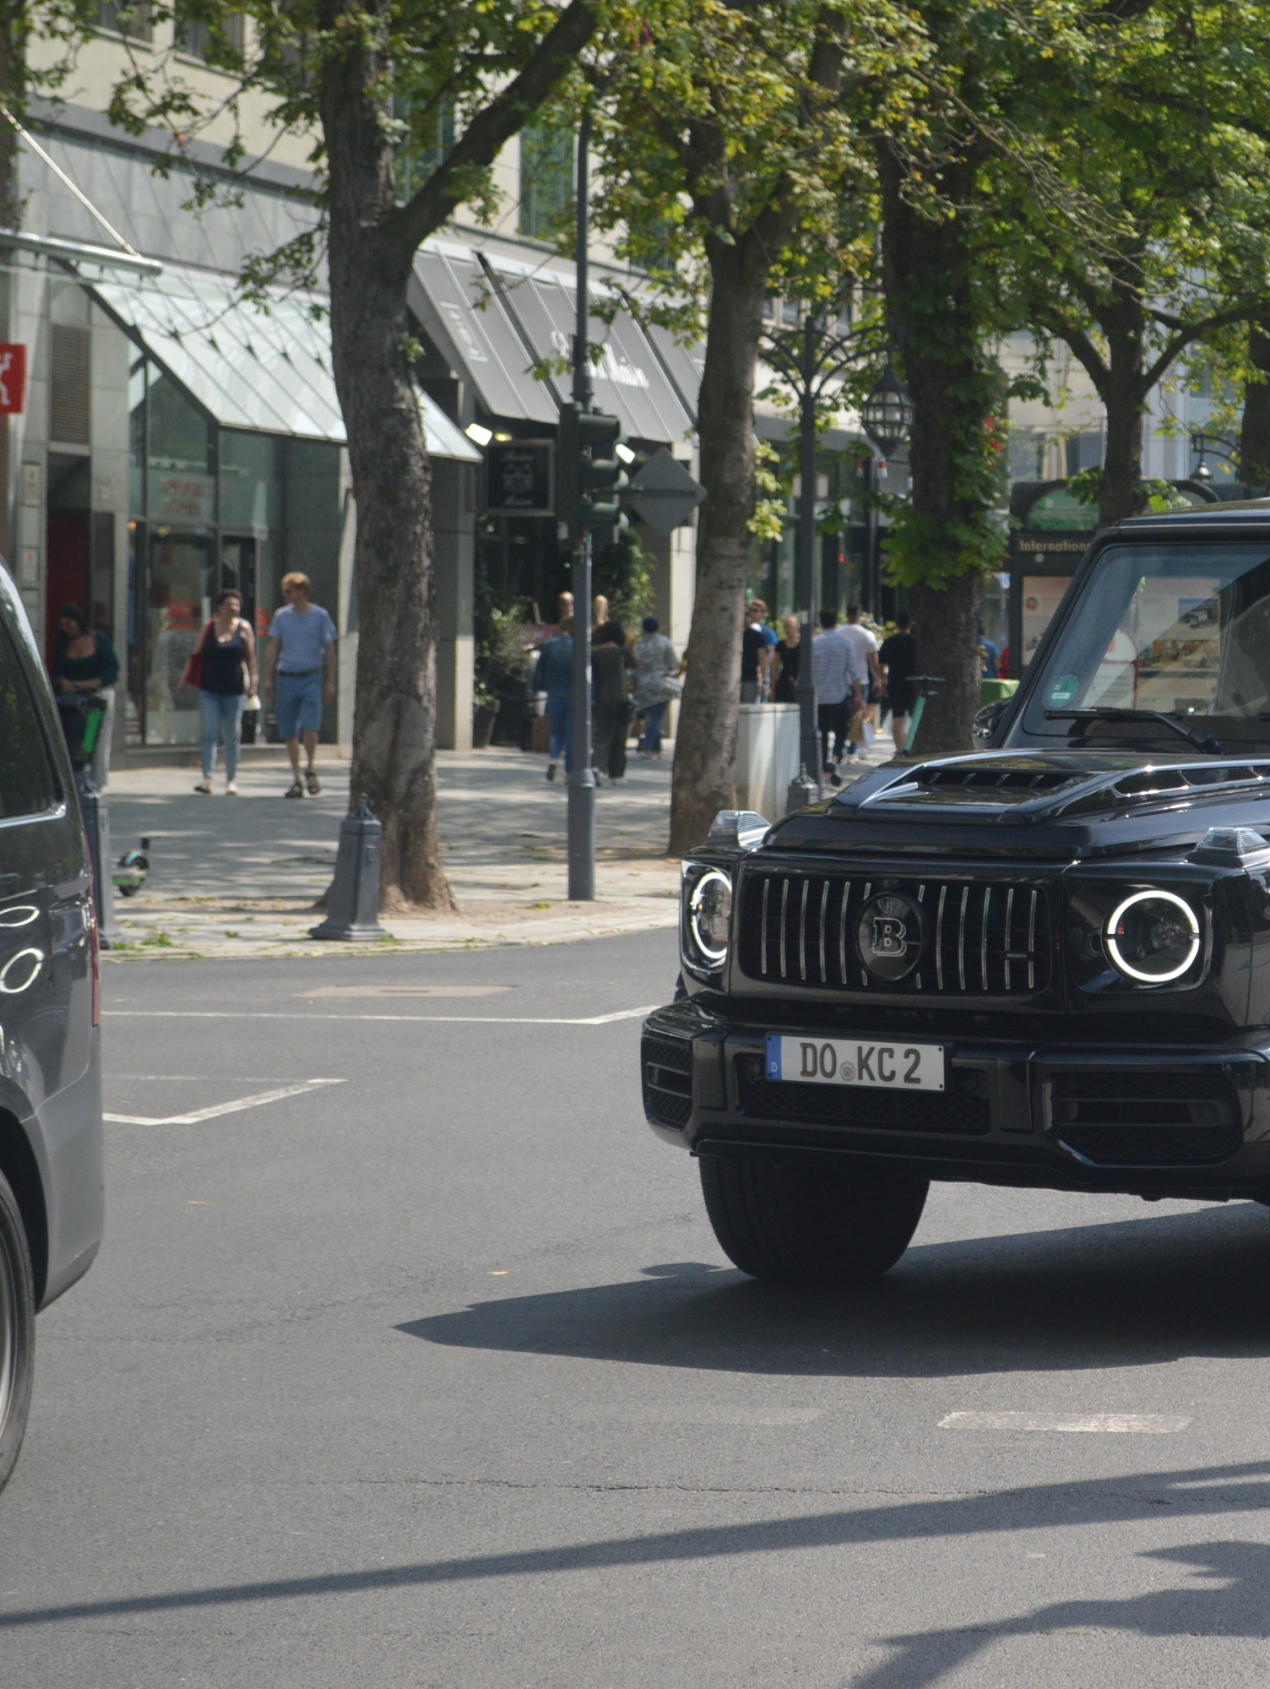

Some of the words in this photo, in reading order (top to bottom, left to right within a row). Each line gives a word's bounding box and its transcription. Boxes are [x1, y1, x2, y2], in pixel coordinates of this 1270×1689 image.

[771, 1062, 778, 1073] D
[800, 1043, 837, 1079] DO
[857, 1046, 896, 1083] KC
